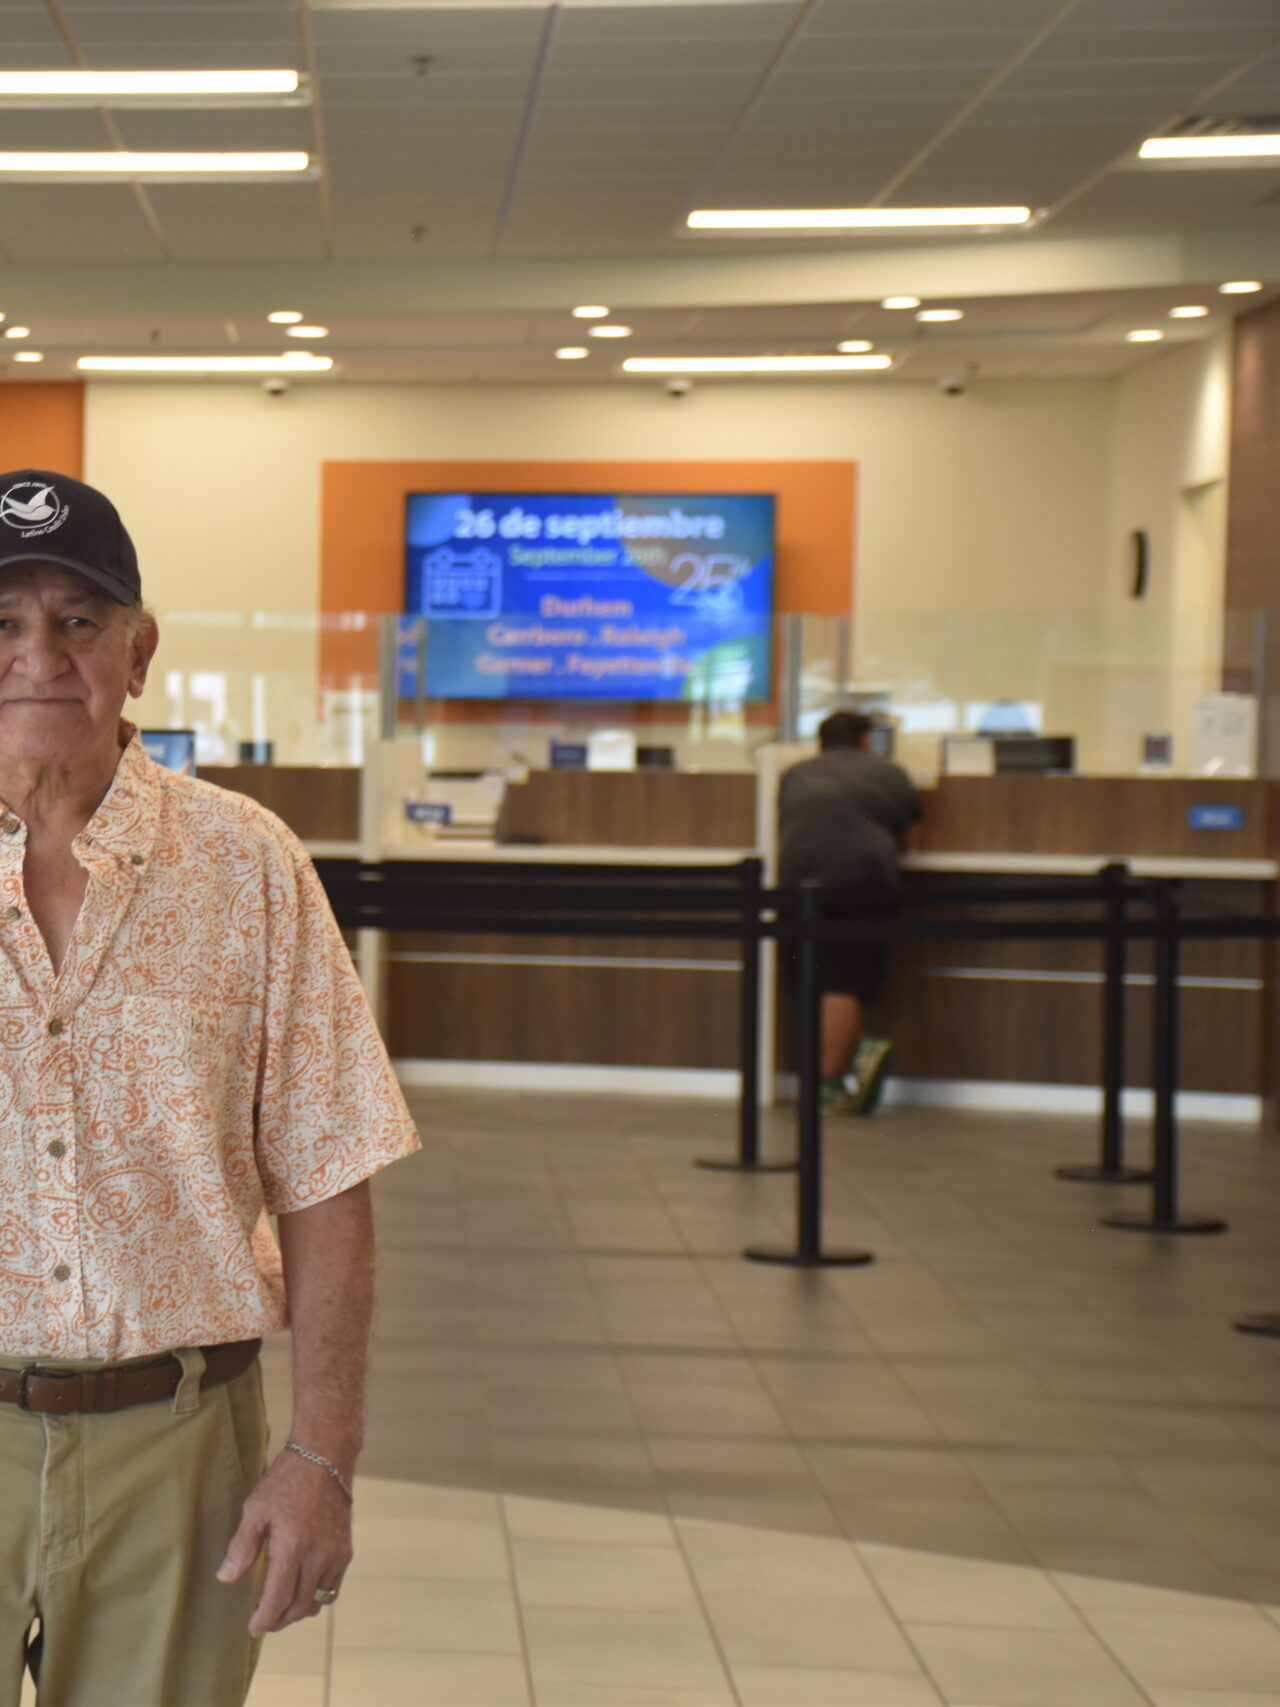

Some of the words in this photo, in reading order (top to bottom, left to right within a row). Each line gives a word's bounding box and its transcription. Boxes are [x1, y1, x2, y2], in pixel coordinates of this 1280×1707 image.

[455, 510, 496, 537] 26
[499, 508, 541, 538] de
[545, 508, 724, 544] septiembre
[542, 596, 632, 617] Durham
